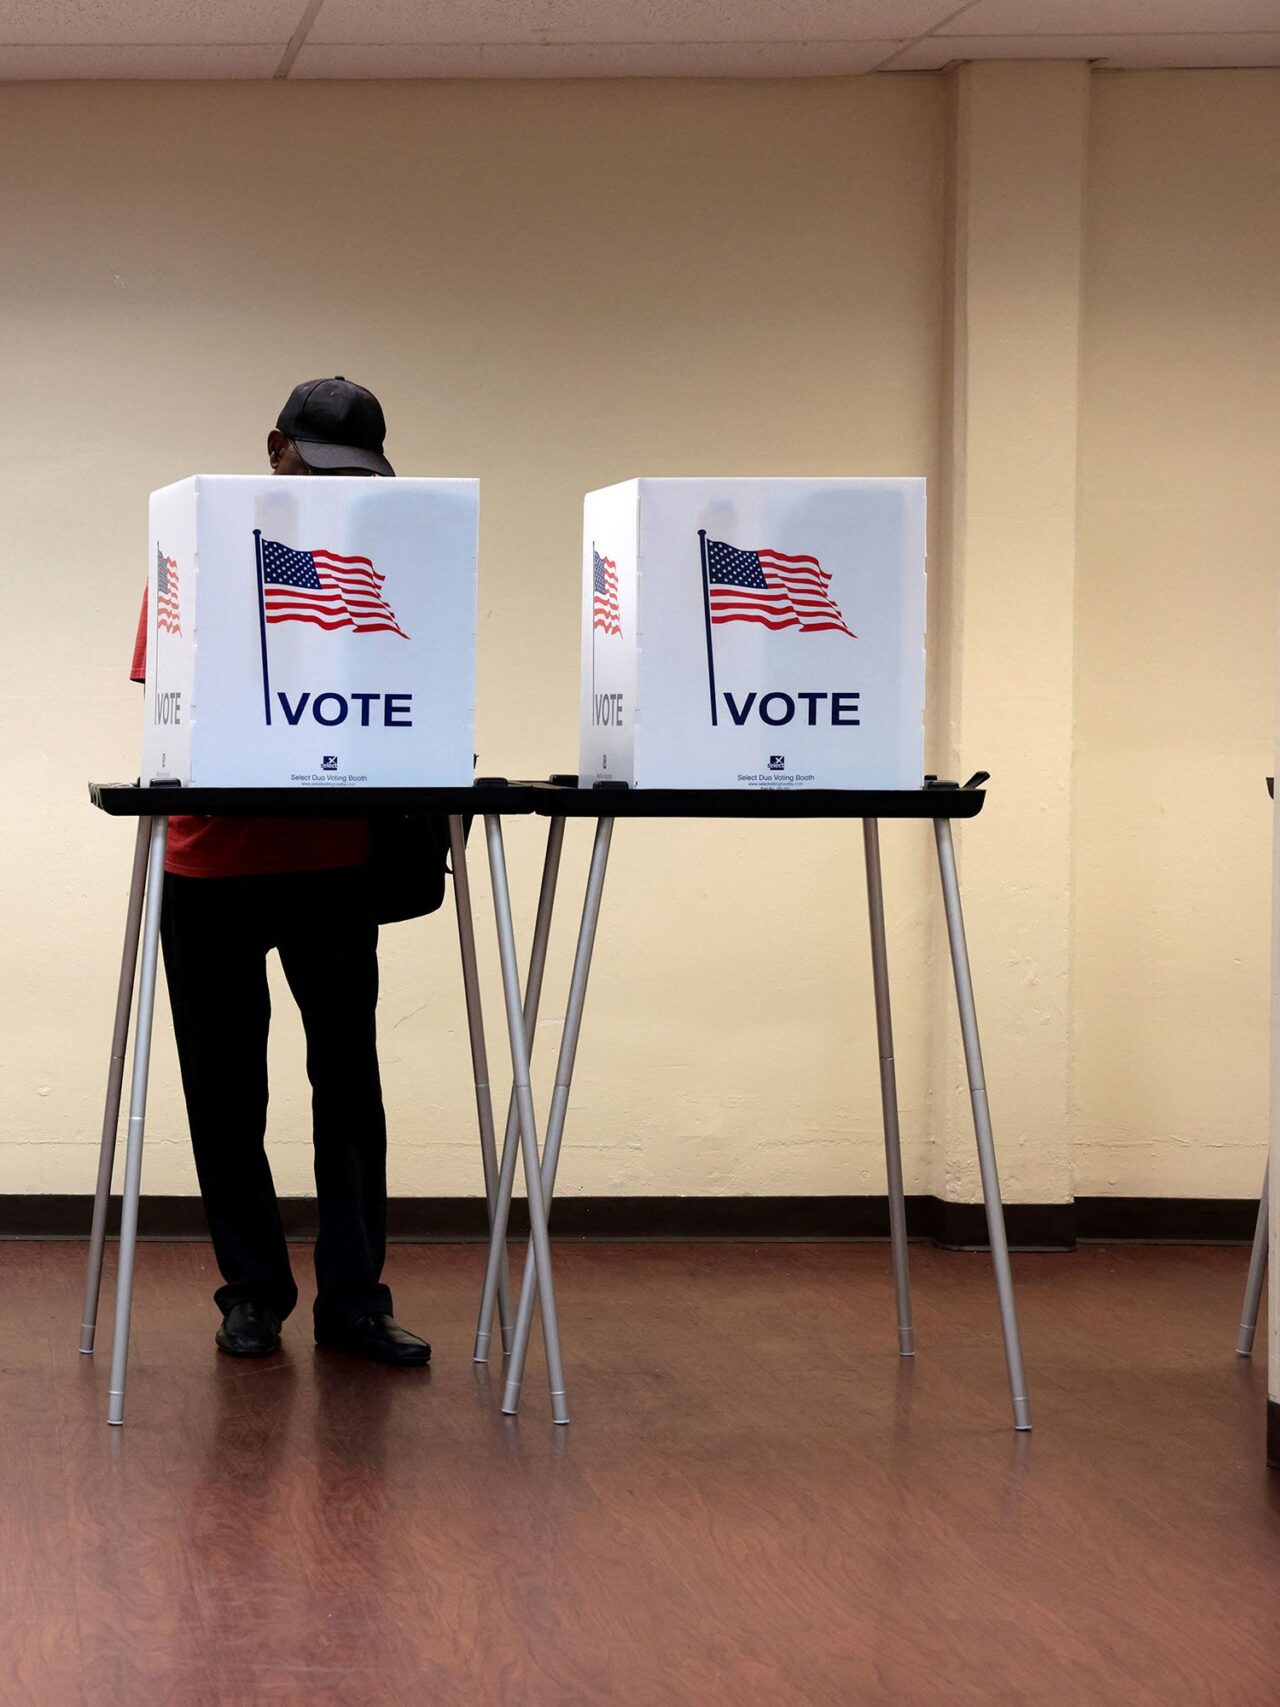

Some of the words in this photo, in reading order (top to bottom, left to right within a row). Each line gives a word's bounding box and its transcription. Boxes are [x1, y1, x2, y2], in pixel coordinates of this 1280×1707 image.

[157, 692, 181, 724] VOTE
[277, 692, 412, 727] VOTE
[594, 694, 623, 726] VOTE
[723, 692, 860, 726] VOTE
[327, 774, 347, 782] Voting
[774, 774, 794, 782] Voting
